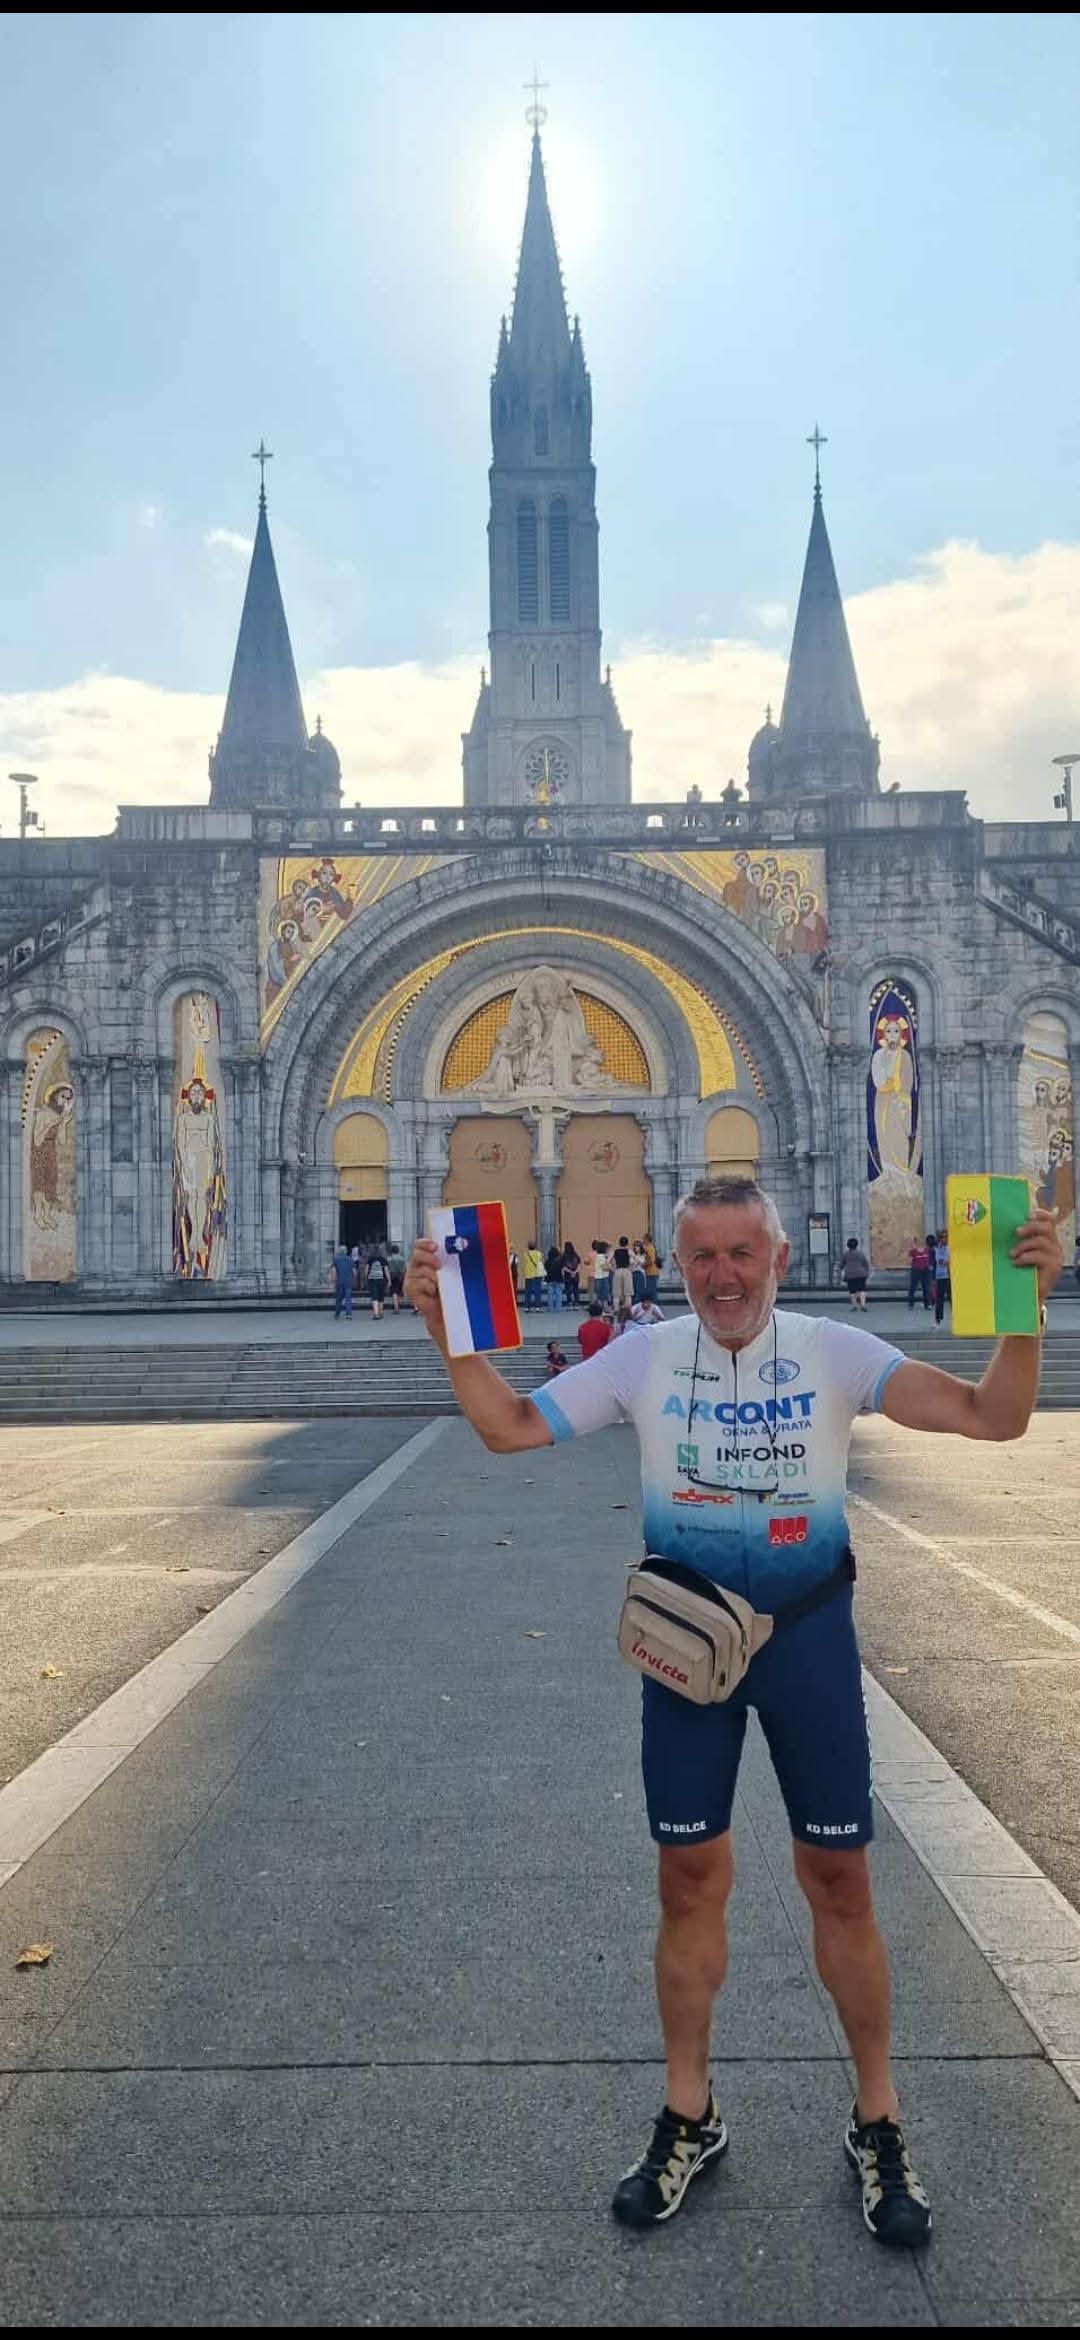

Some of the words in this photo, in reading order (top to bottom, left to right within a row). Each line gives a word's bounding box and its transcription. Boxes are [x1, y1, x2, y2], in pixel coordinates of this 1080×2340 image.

[662, 1391, 816, 1424] ARCONT
[717, 1444, 806, 1461] INFOND
[715, 1461, 807, 1480] SKLADI
[771, 1532, 806, 1544] ACO
[672, 1820, 707, 1833] SELCE
[806, 1823, 821, 1834] KD
[823, 1823, 858, 1835] SELCE
